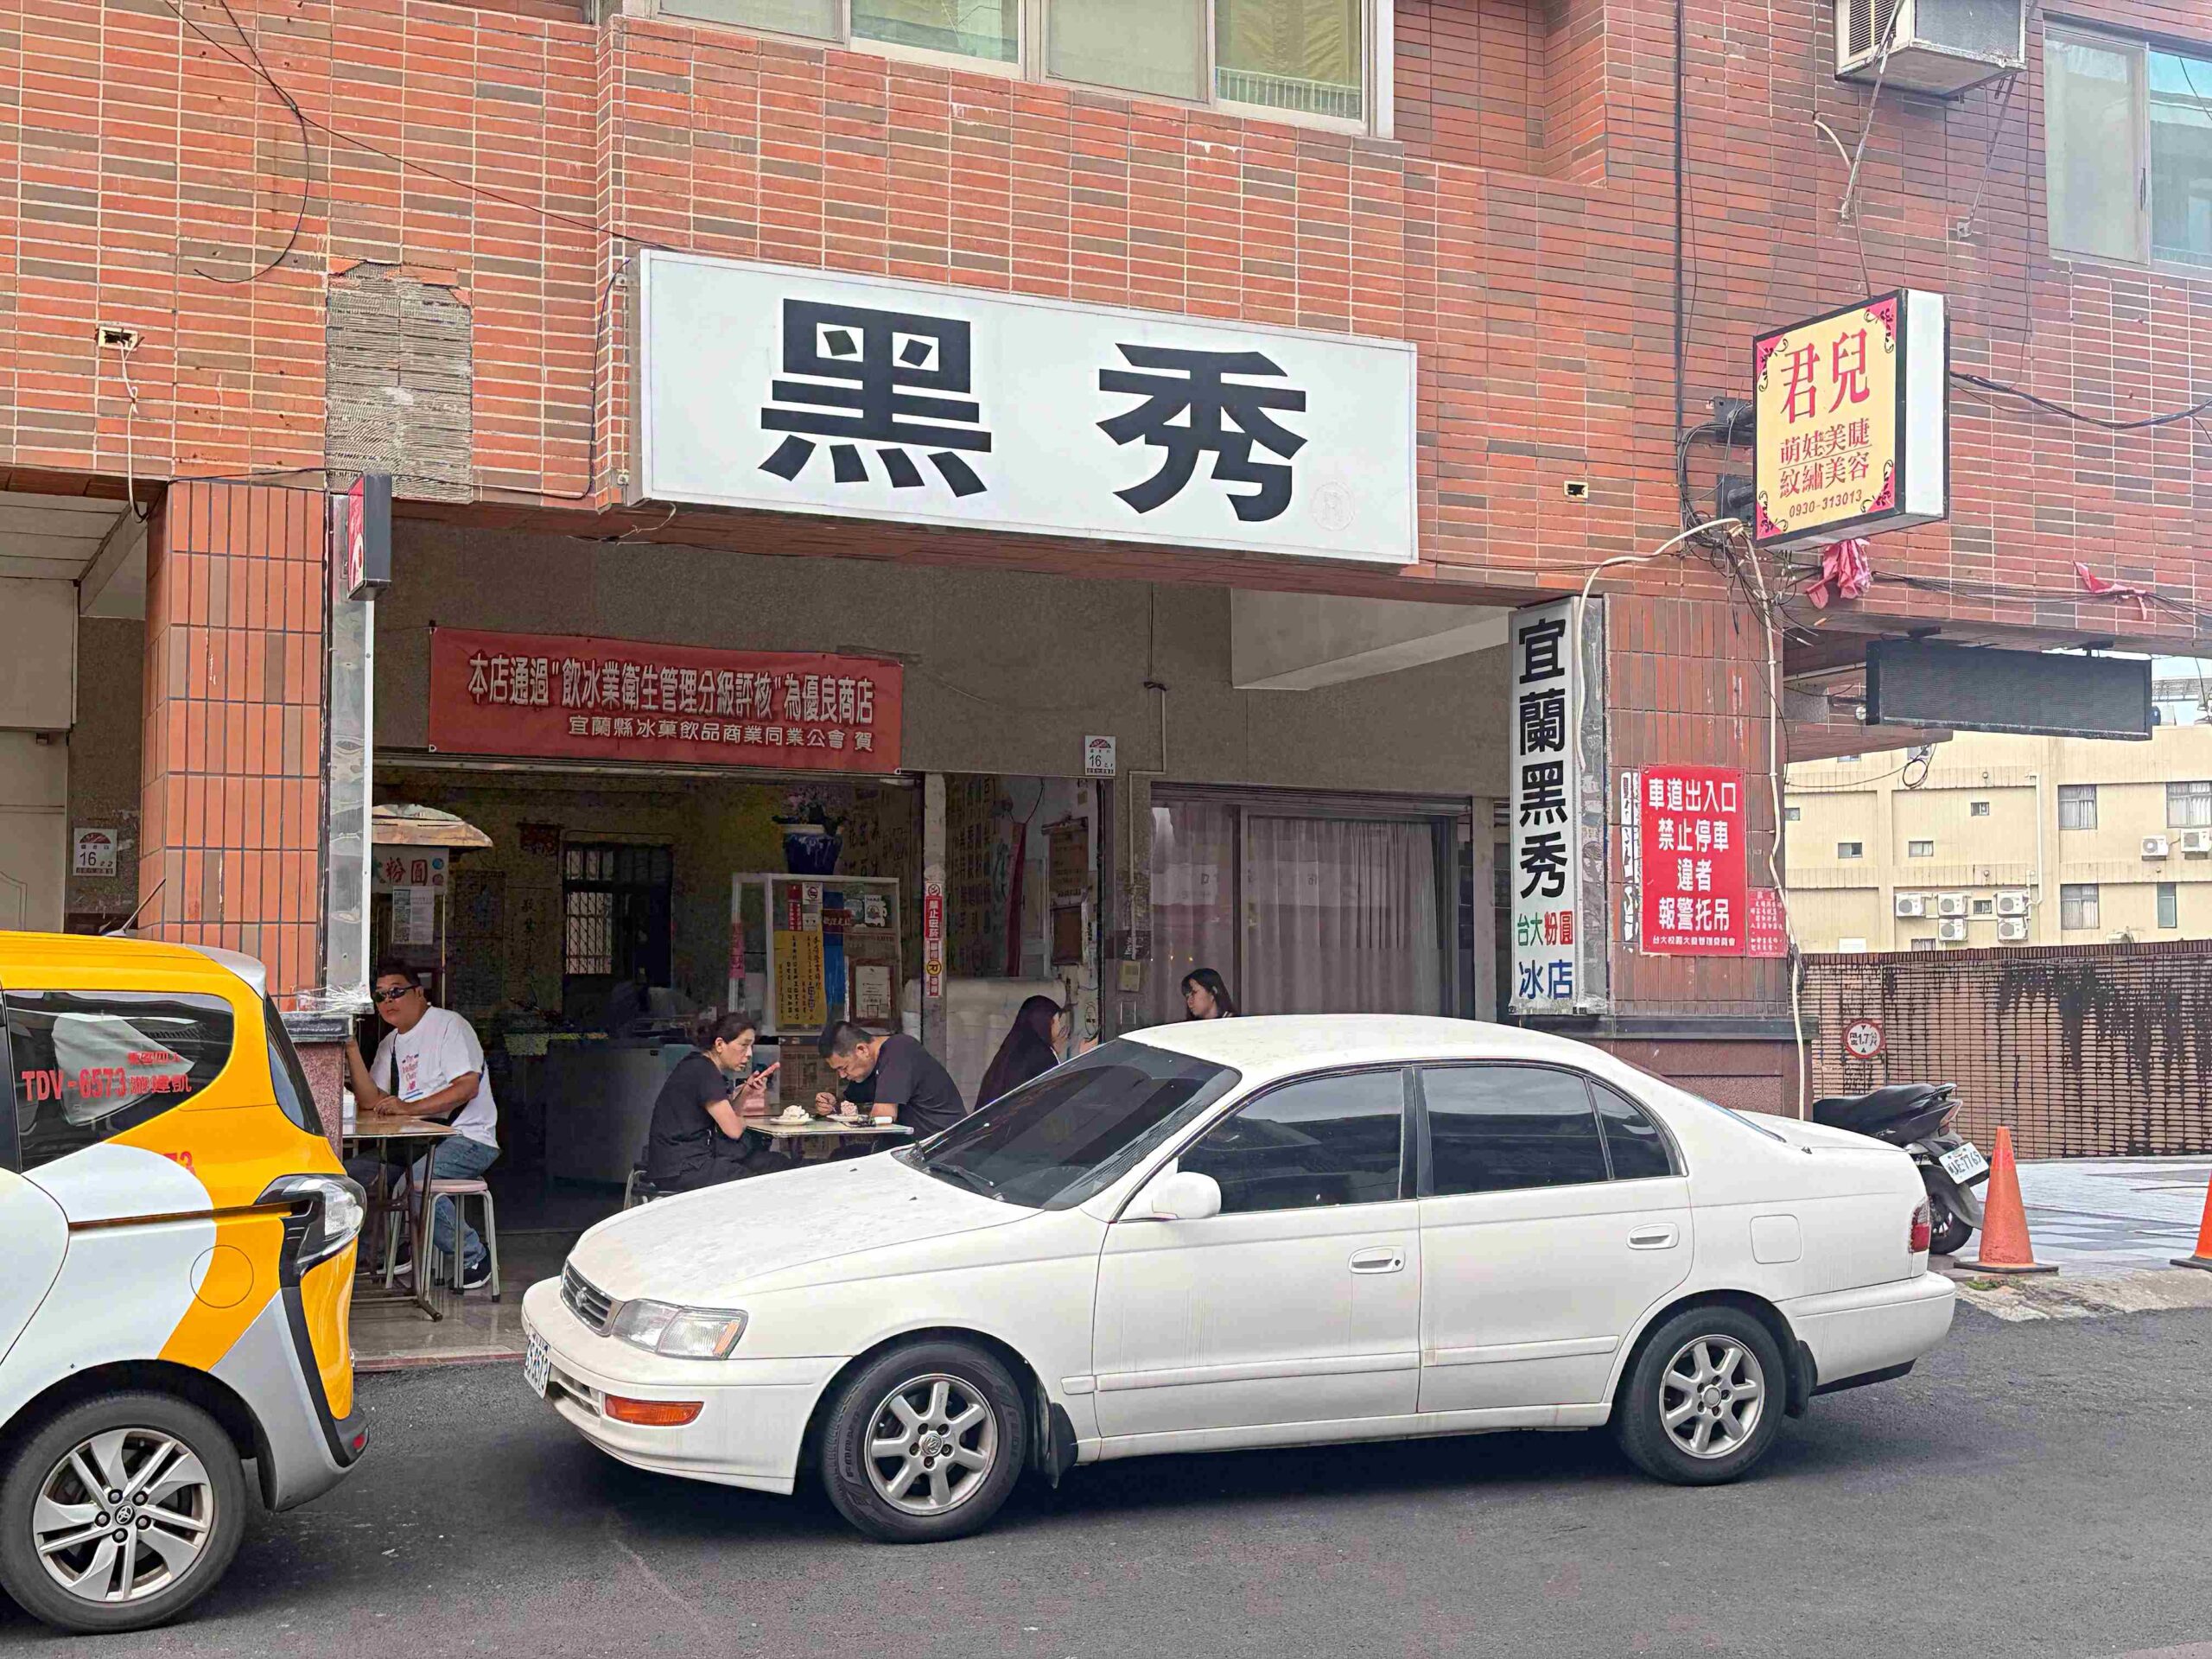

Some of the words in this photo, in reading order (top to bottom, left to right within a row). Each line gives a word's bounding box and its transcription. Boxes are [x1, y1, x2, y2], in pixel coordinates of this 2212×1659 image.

[1781, 328, 1870, 424] 君兒
[759, 299, 1307, 522] 黑秀
[1789, 489, 1863, 518] 0930-313013
[1090, 754, 1101, 767] 16
[1518, 618, 1567, 899] 宜蘭黑秀
[1649, 778, 1737, 813] 車道出入口
[1658, 818, 1729, 853] 禁止停車
[80, 852, 96, 866] 16
[1677, 858, 1713, 892] 違者
[1517, 911, 1573, 946] 台大粉圓
[1659, 897, 1729, 931] 報警托吊
[1518, 959, 1573, 1000] 冰店
[22, 1067, 127, 1101] TDV-6573
